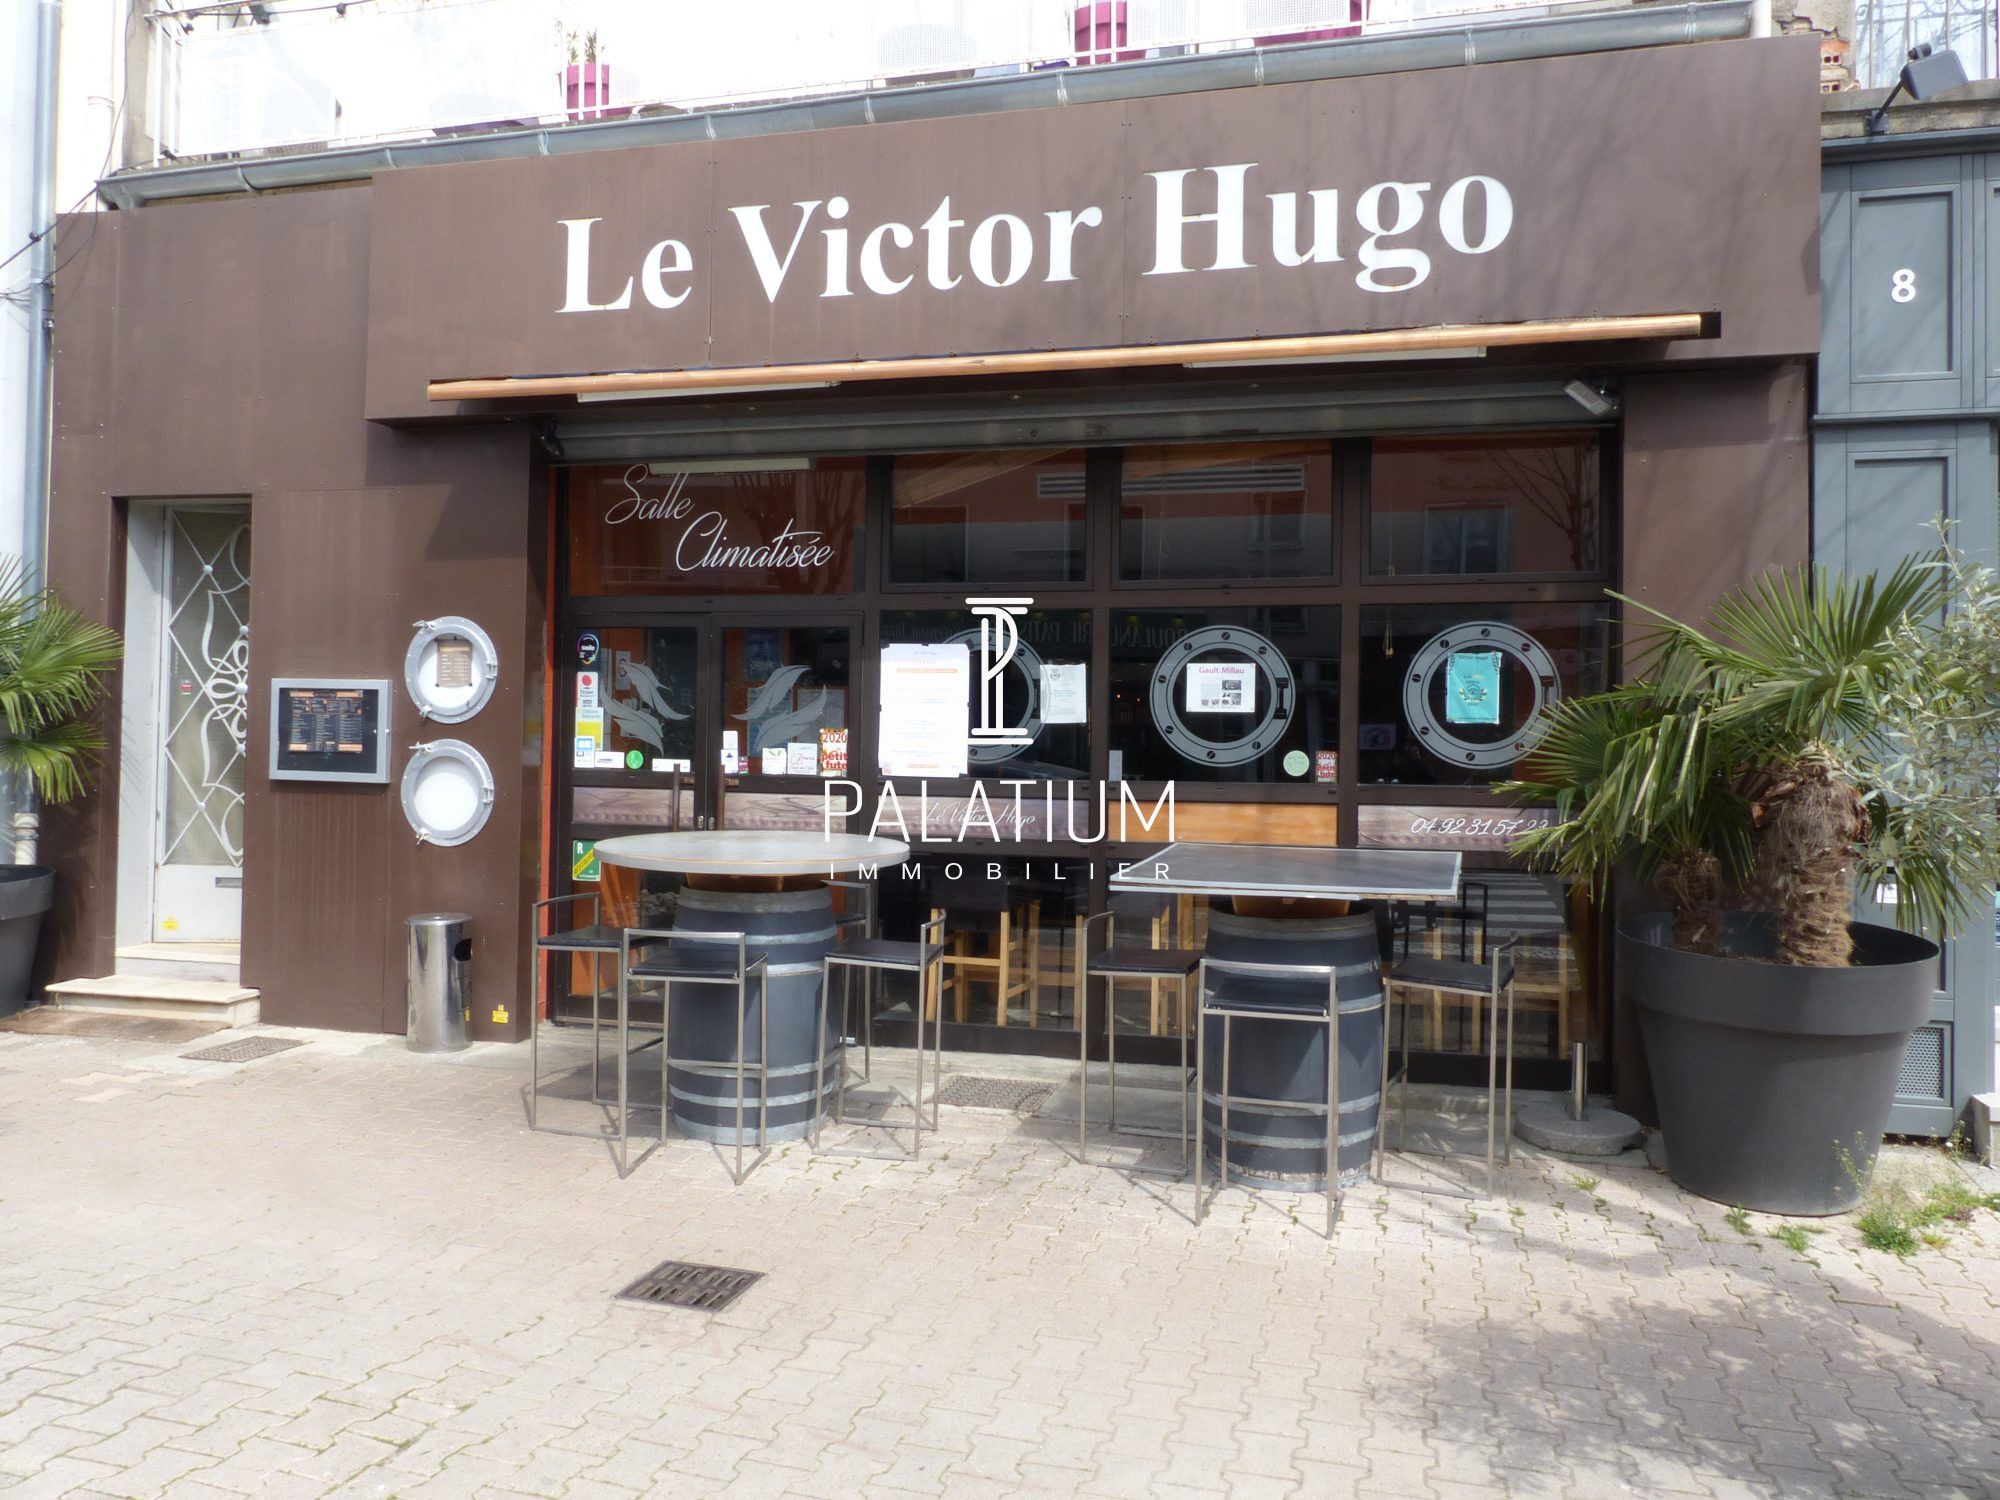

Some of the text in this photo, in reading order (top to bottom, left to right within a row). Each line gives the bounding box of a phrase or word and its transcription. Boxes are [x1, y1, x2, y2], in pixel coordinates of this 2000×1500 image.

[555, 162, 1514, 313] Le Victor Hugo
[1891, 268, 1916, 303] 8
[605, 463, 696, 525] Salle
[675, 511, 836, 571] Climatisée
[1198, 666, 1245, 674] Gault Millau
[822, 732, 847, 743] 2020
[821, 750, 848, 762] petit
[1316, 752, 1335, 760] 2020
[1410, 817, 1438, 834] 04
[1438, 818, 1466, 834] 92
[1465, 818, 1493, 836] 31
[1492, 819, 1525, 837] 57
[576, 842, 584, 854] R
